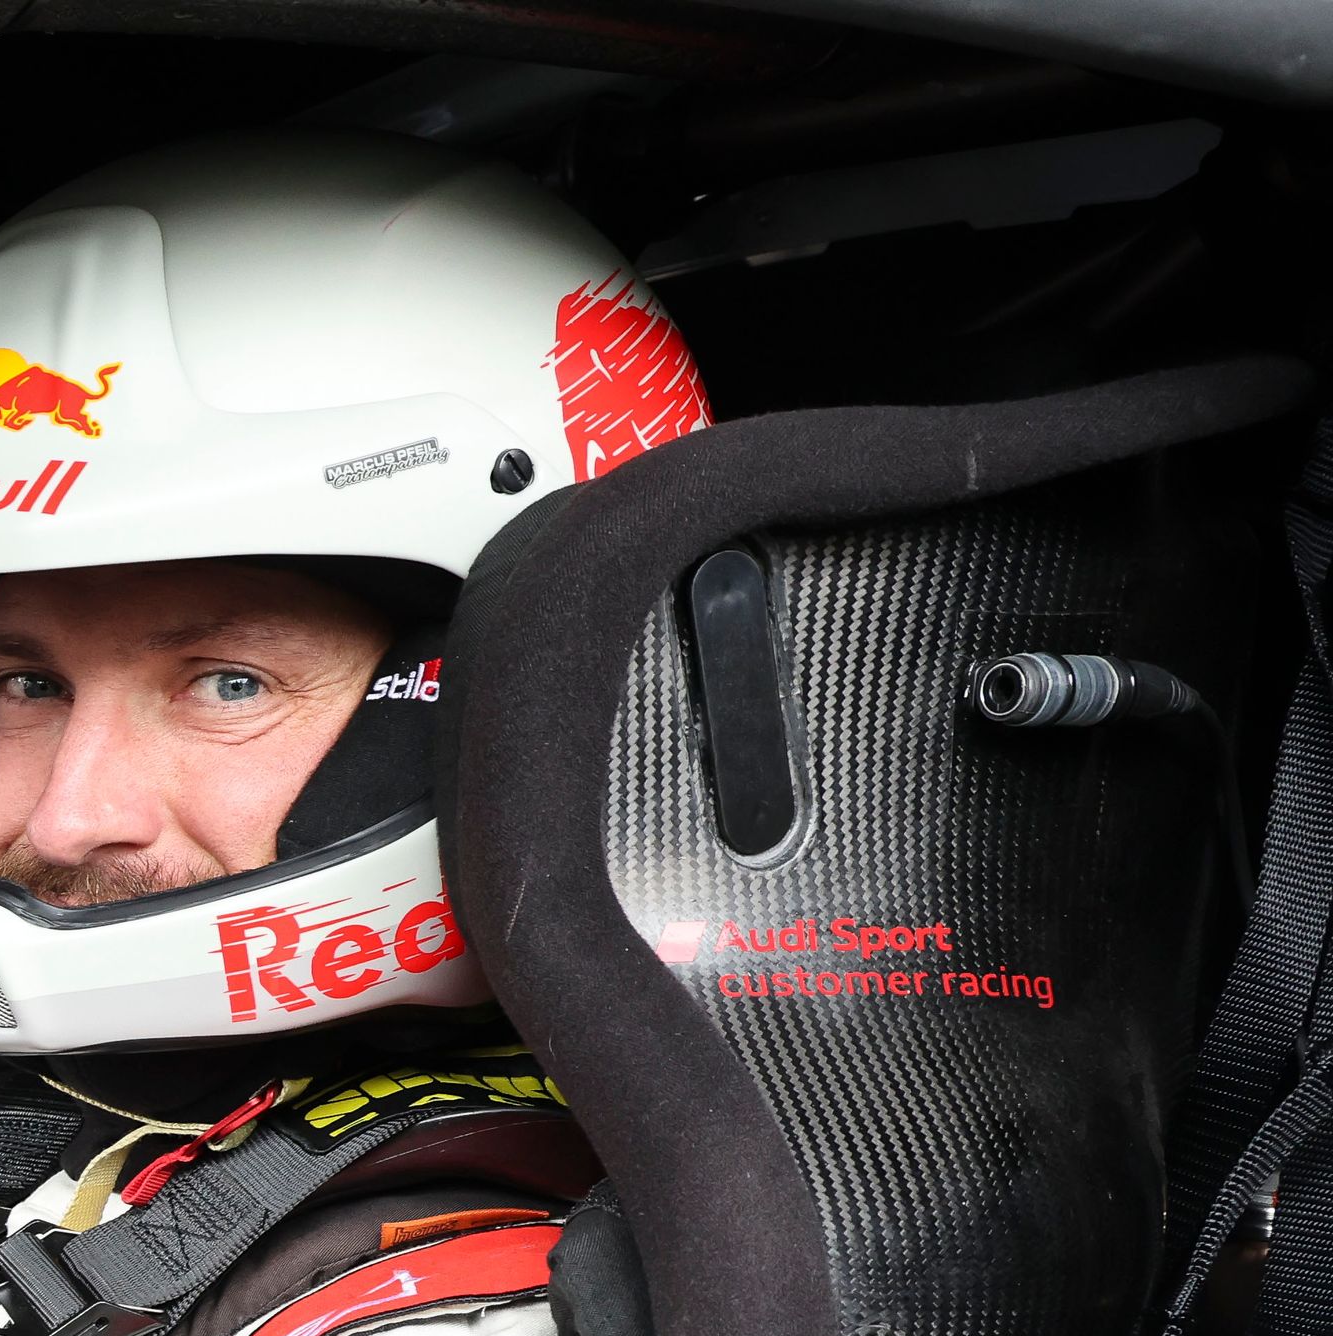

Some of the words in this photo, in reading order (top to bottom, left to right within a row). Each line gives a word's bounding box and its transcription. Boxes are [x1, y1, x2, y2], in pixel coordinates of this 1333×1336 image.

[327, 453, 396, 482] MARCUS
[396, 440, 438, 462] PFEIL
[713, 920, 820, 954] Audi
[830, 917, 953, 959] Sport
[718, 964, 926, 1001] customer
[941, 965, 1054, 1008] racing
